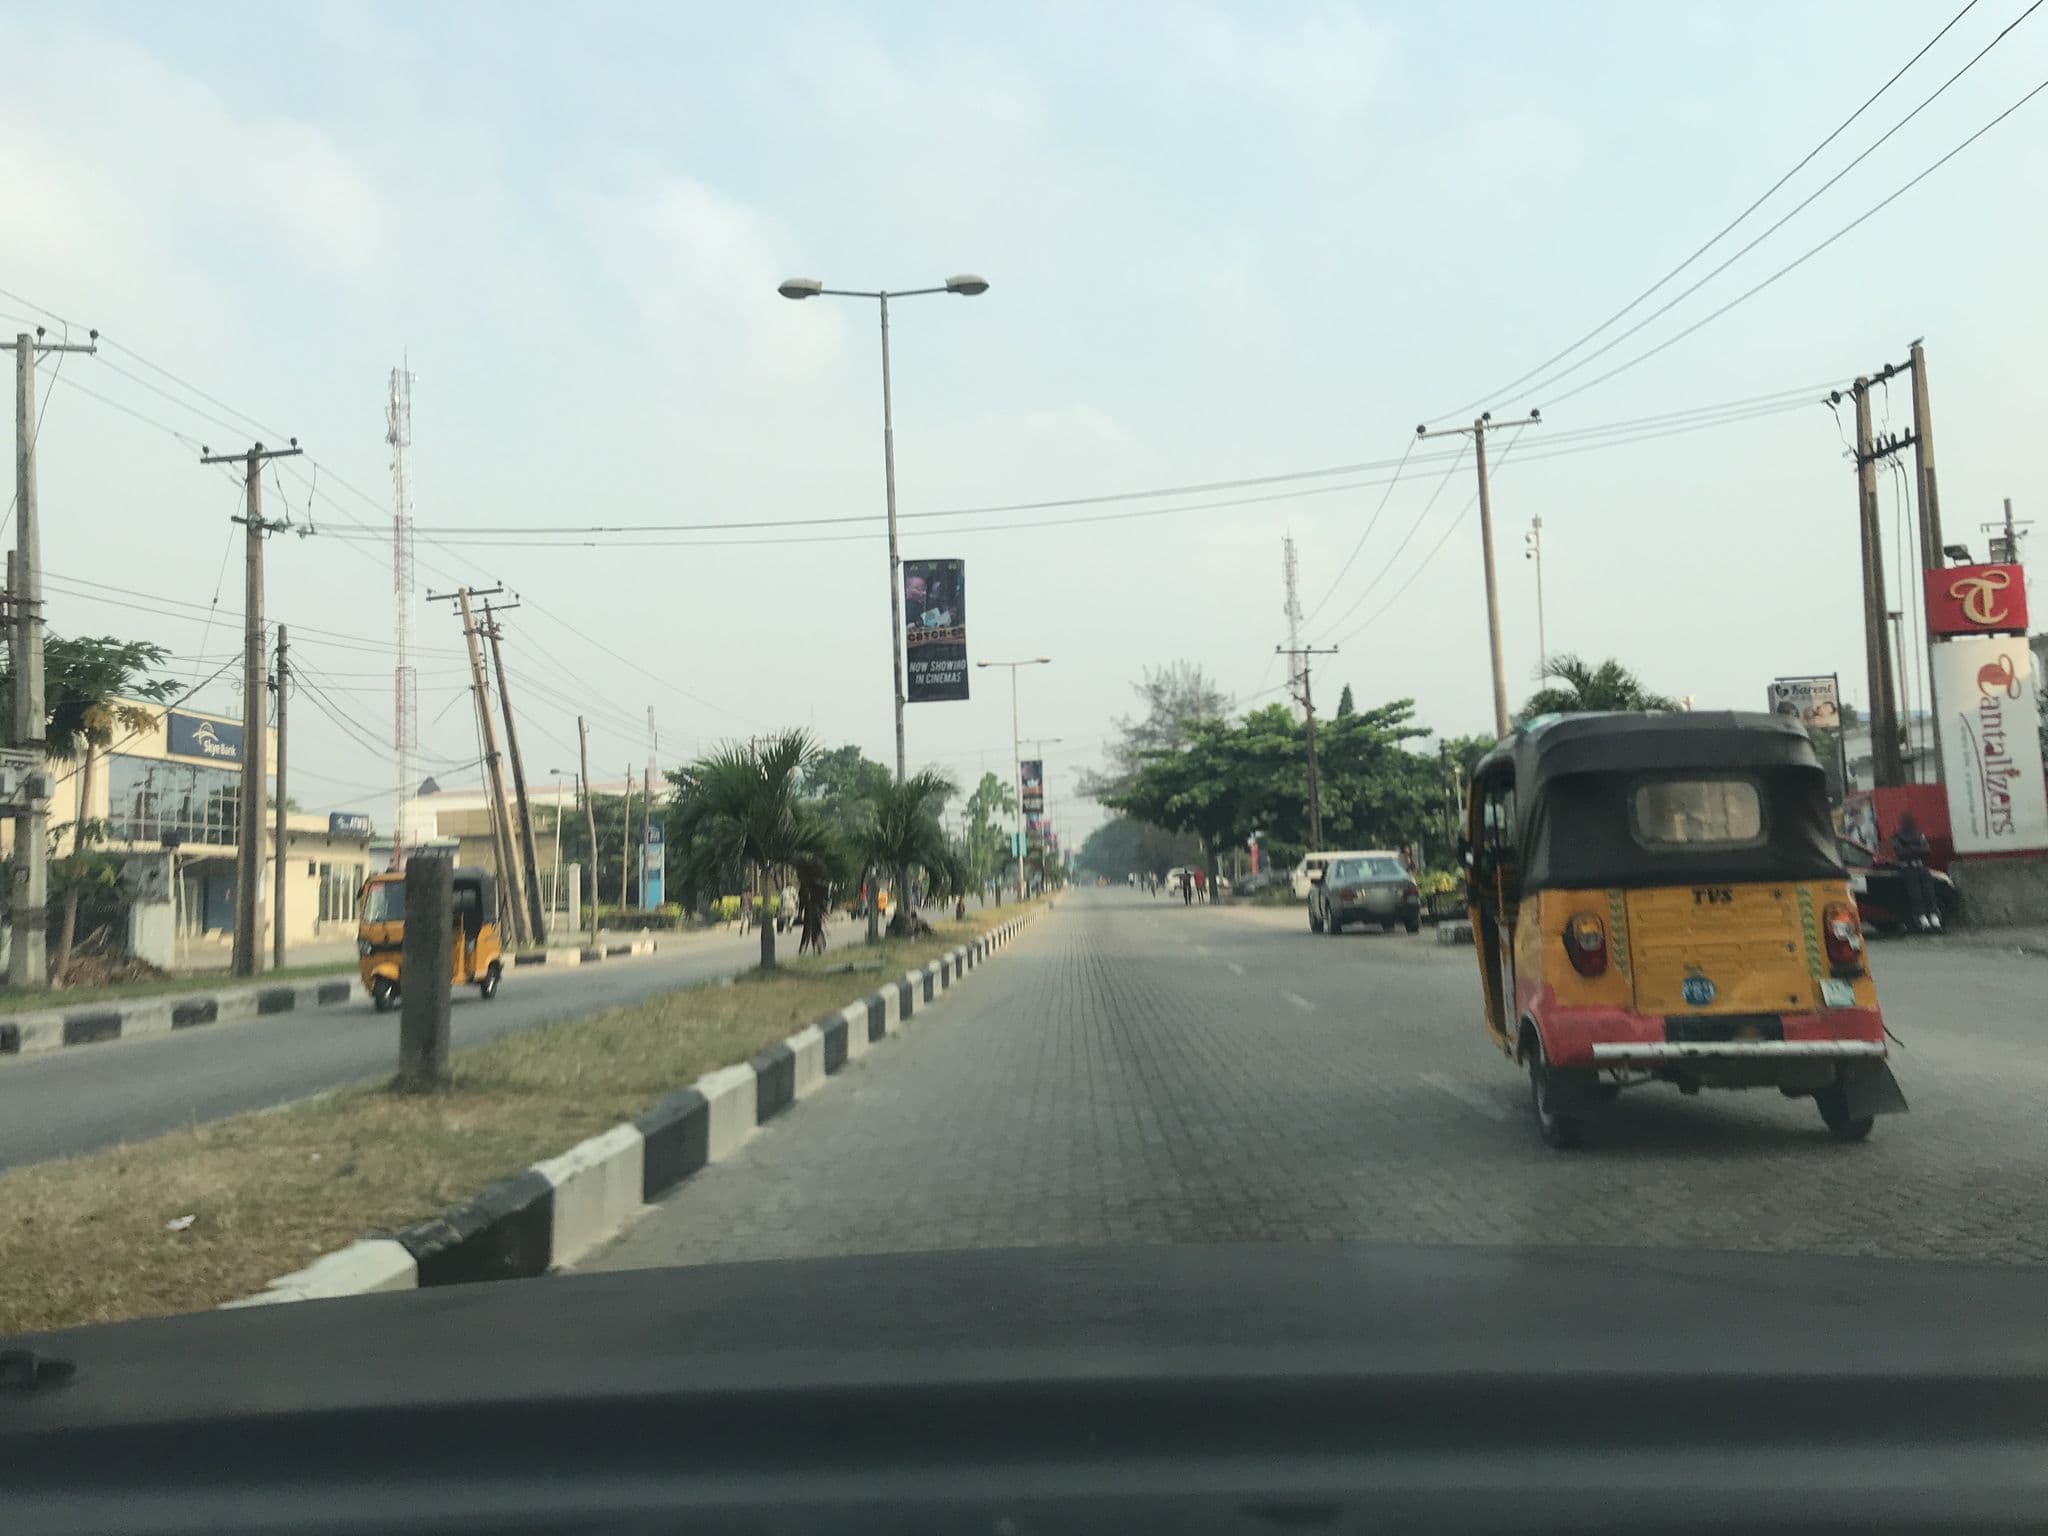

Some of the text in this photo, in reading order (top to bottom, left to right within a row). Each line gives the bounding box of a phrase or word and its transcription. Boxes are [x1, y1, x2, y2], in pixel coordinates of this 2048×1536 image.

[909, 659, 966, 673] NOW SHOWING
[915, 672, 961, 684] IN CINEMAS
[1977, 653, 2022, 837] Tantalizers
